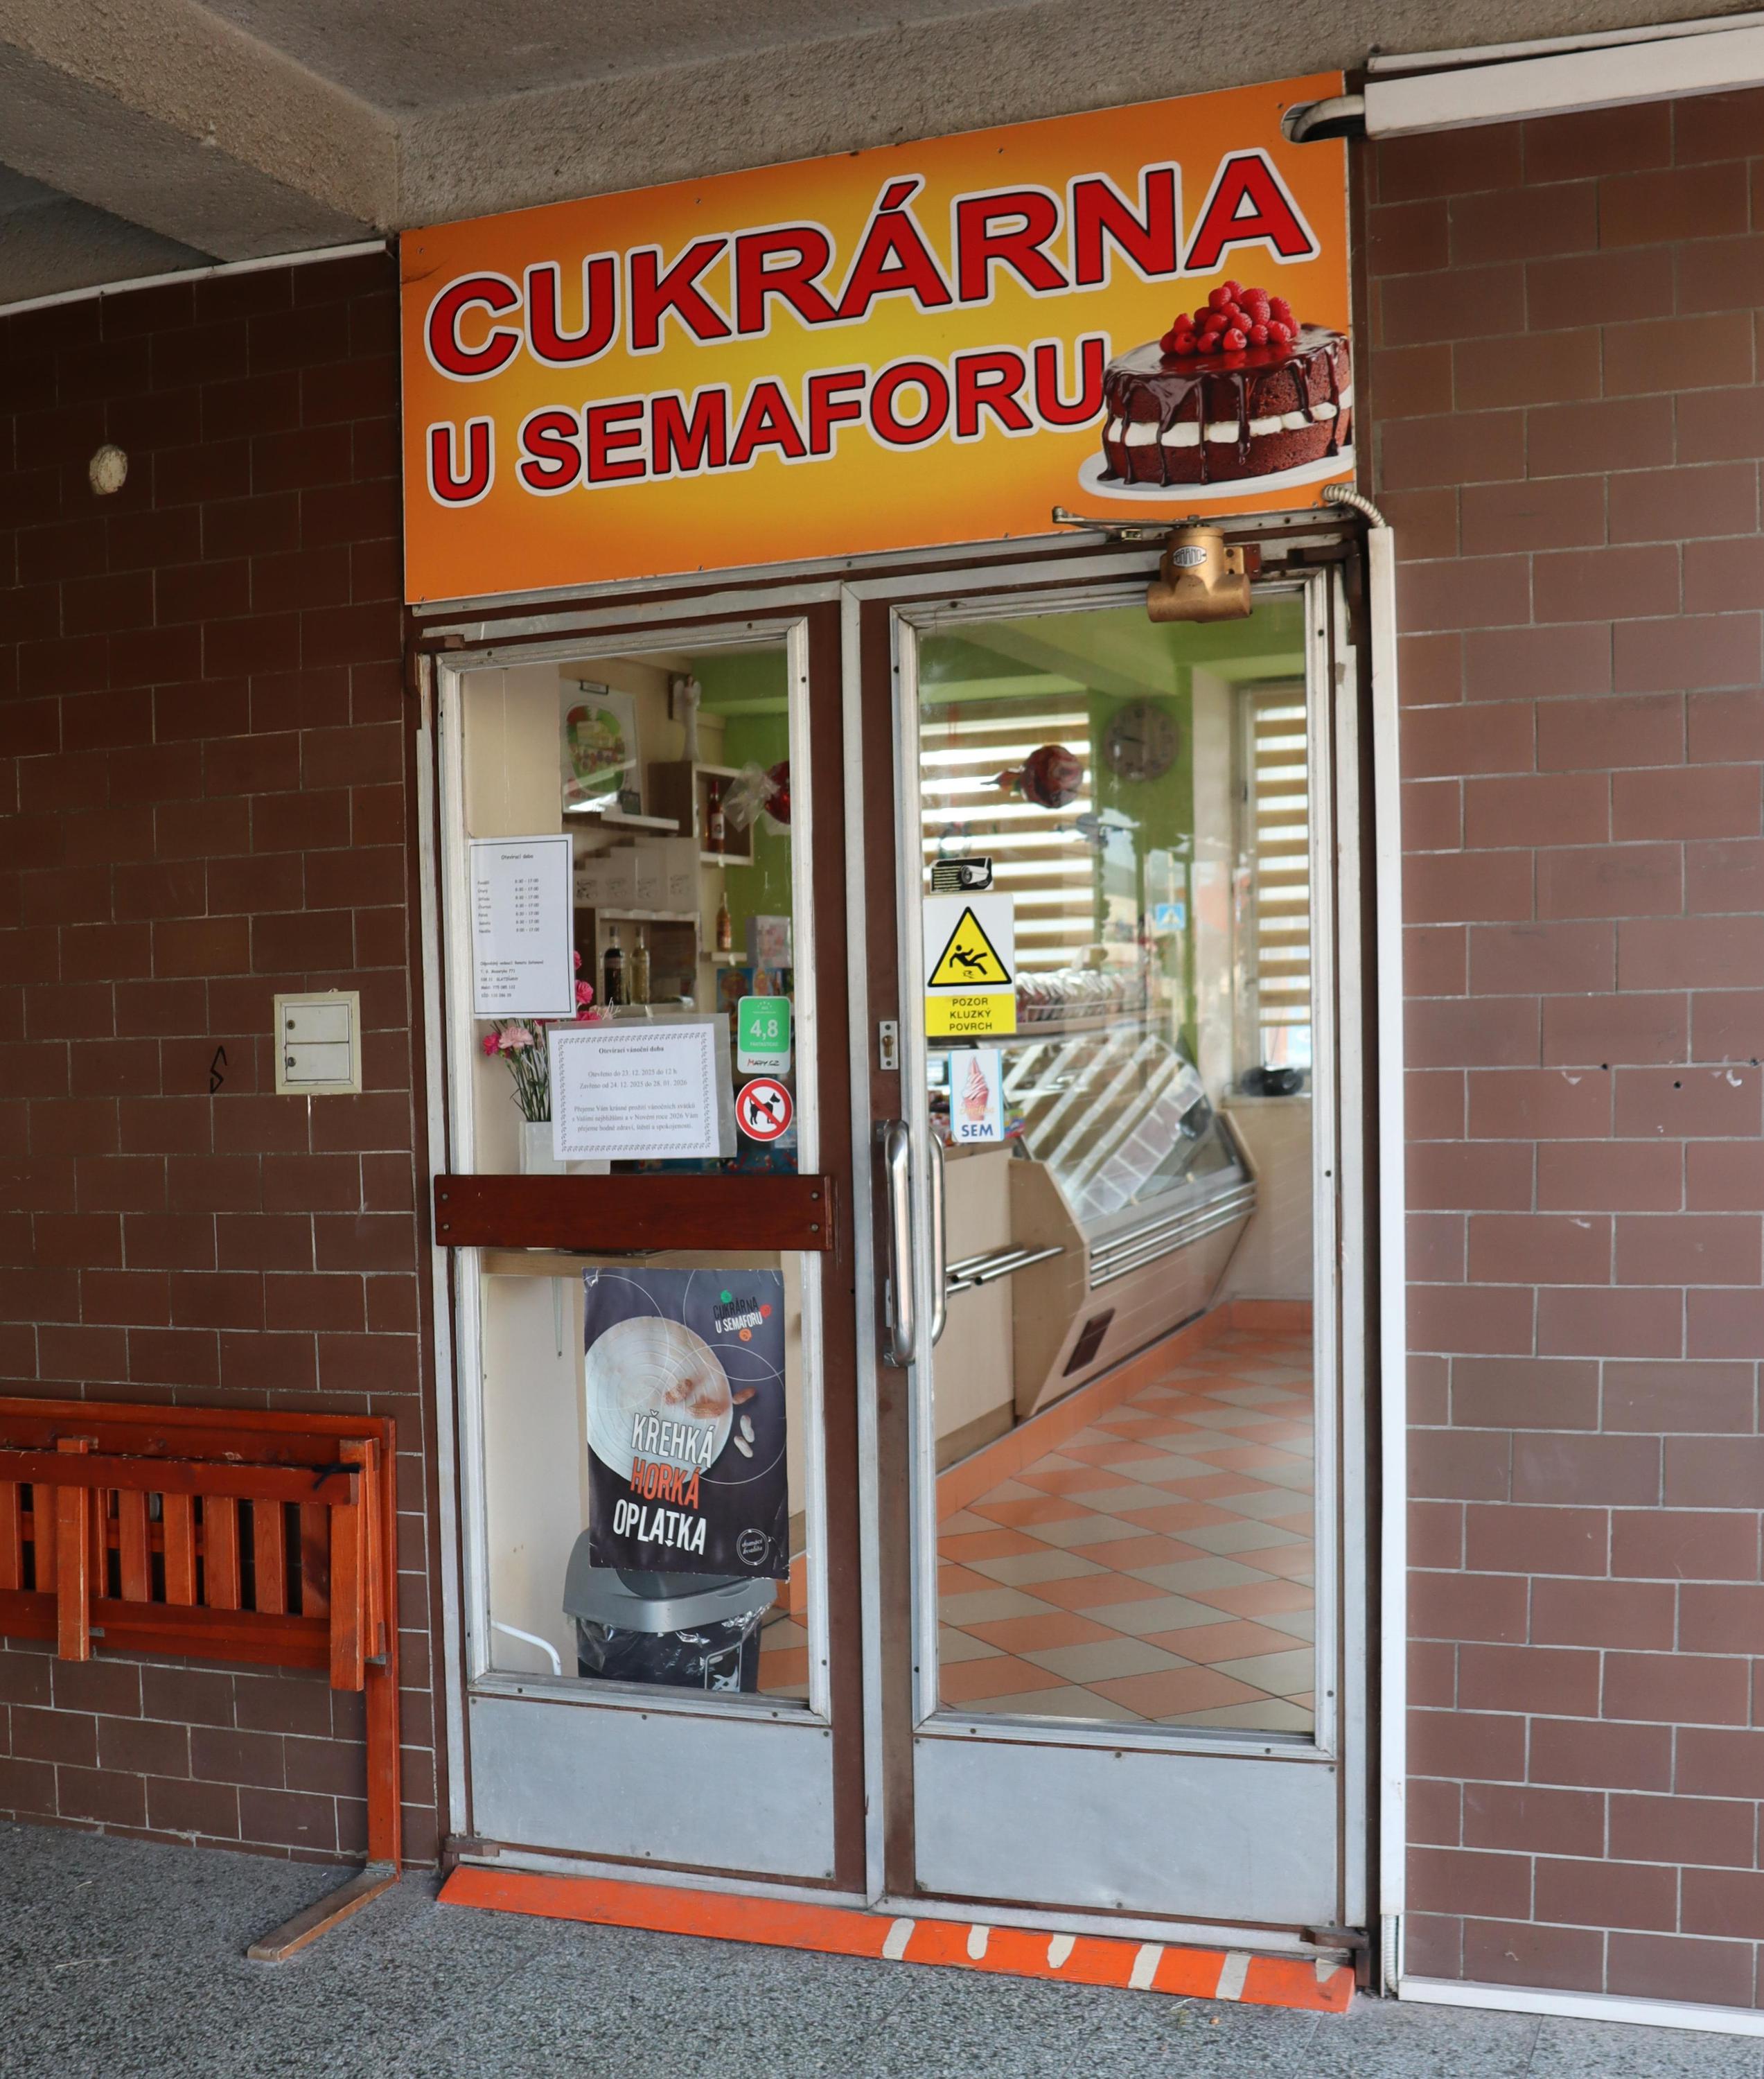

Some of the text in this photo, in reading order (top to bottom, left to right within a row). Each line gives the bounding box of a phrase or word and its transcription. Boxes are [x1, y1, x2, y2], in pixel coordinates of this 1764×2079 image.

[427, 152, 1315, 378] CUKRÁRNA
[430, 338, 1108, 502] U SEMAFORU
[952, 997, 989, 1007] POZOR
[950, 1008, 991, 1019] KLUZKÝ
[750, 1019, 779, 1040] 4,8
[949, 1022, 992, 1031] POVRCH
[961, 1123, 994, 1137] SEM
[713, 1296, 759, 1319] CUKRÁRNA
[715, 1311, 763, 1333] U SEMAFORU
[631, 1408, 716, 1468] KŘEHKÁ
[630, 1456, 702, 1509] HORKÁ
[612, 1498, 707, 1555] OPLATKA
